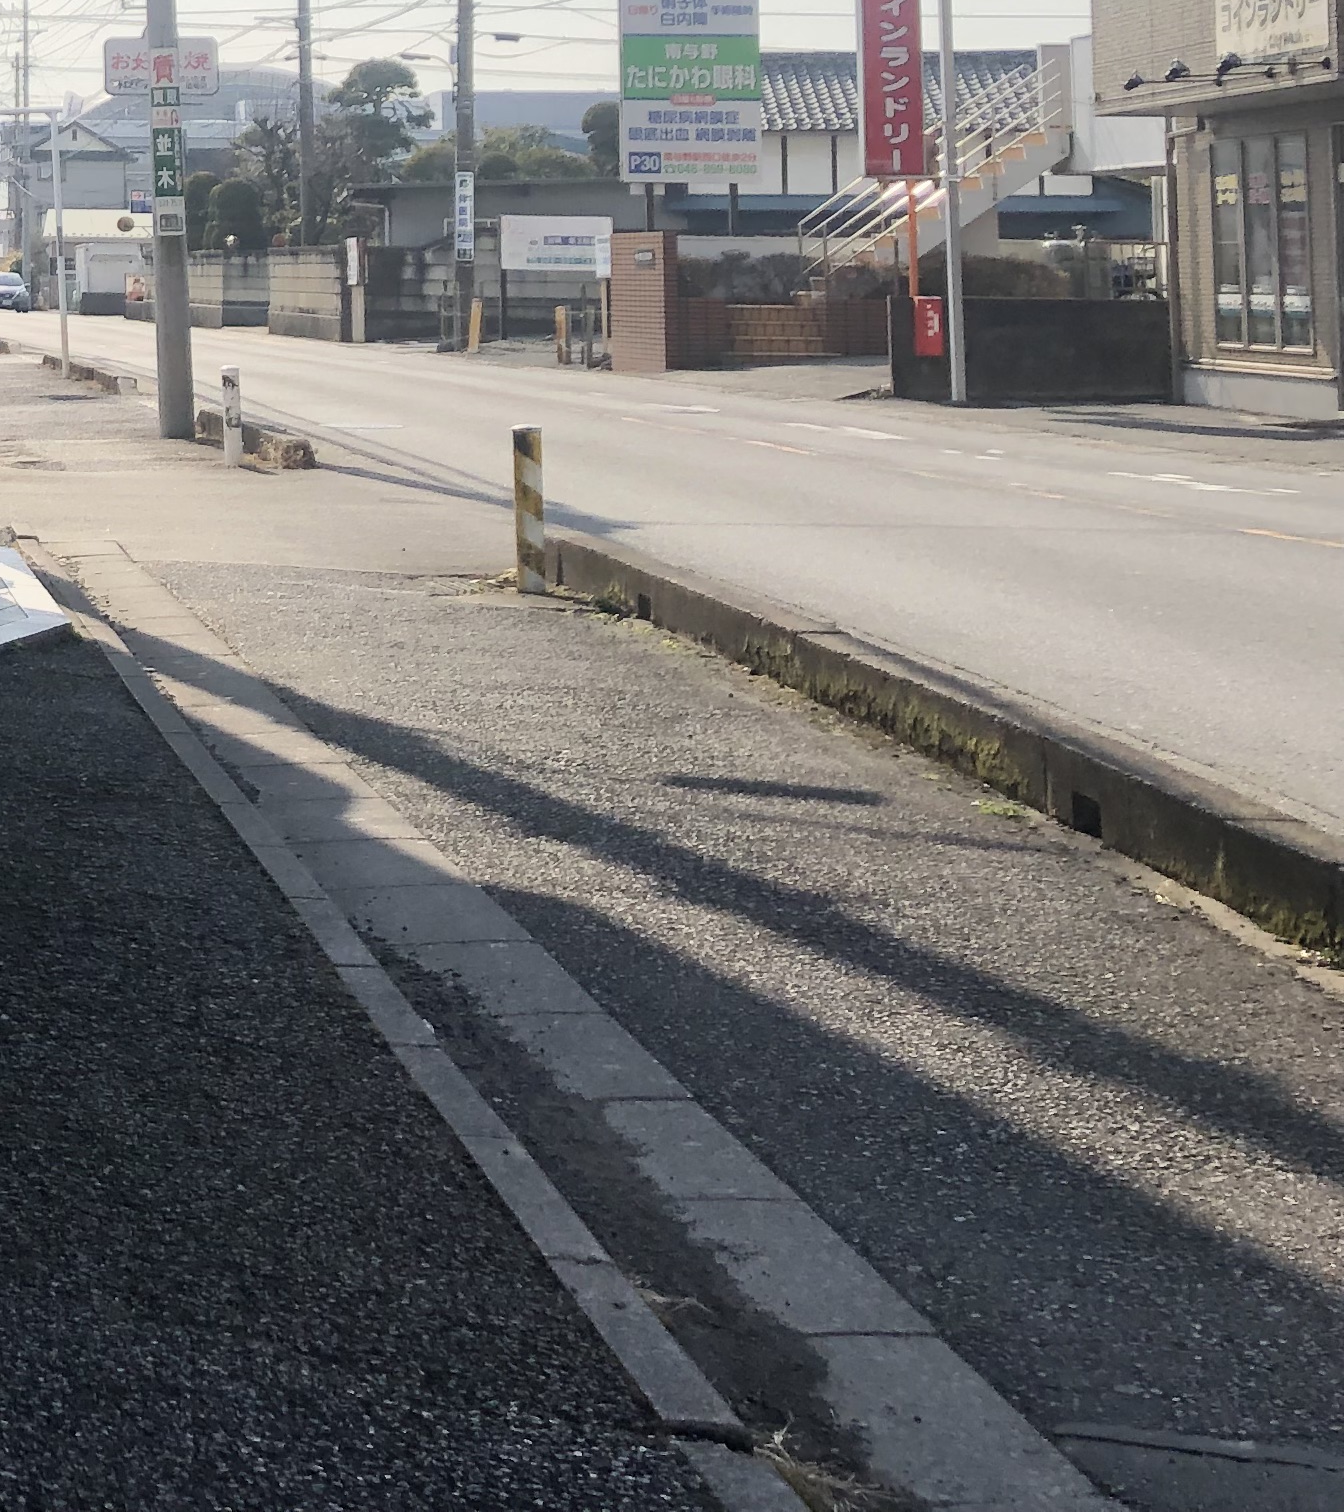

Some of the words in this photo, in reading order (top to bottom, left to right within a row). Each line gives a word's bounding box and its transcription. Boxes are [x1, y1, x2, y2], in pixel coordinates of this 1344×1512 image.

[627, 65, 756, 89] たにかわ眼科
[156, 134, 174, 189] 並木
[631, 155, 659, 170] P30
